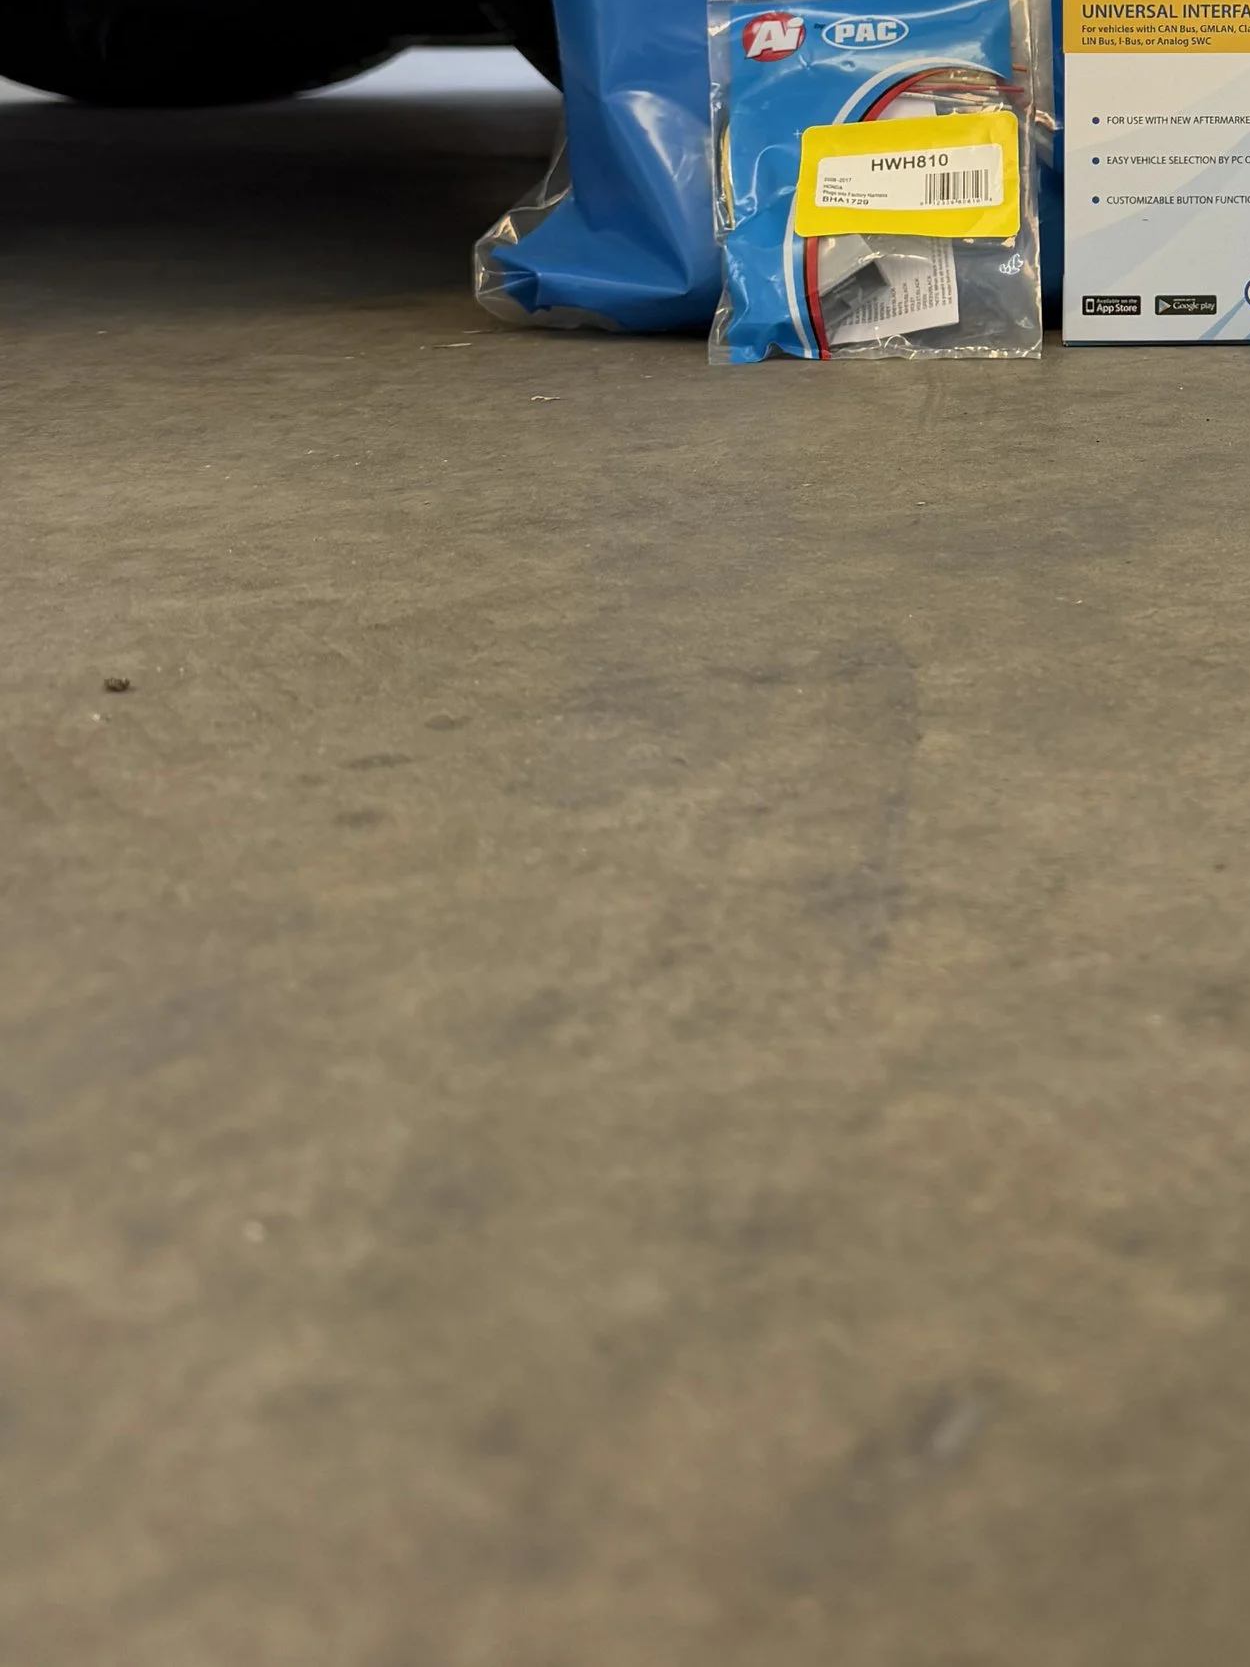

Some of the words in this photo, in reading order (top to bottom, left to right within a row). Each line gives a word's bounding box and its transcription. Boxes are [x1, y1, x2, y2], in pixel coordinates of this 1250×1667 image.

[1082, 4, 1178, 18] UNIVERSAL
[1082, 25, 1096, 33] For
[1098, 24, 1134, 33] vehicles
[1136, 24, 1156, 33] with
[1158, 25, 1178, 34] CAN
[1180, 25, 1198, 35] Bus,
[1200, 25, 1237, 35] GMLAN,
[747, 17, 804, 58] Ai
[835, 22, 897, 43] PAC
[1082, 37, 1096, 46] LIN
[1099, 37, 1117, 46] Bus,
[1119, 37, 1144, 46] I-Bus,
[1145, 38, 1155, 46] or
[1157, 37, 1189, 47] Analog
[1191, 37, 1212, 46] SWC
[1107, 116, 1125, 124] FOR
[1126, 116, 1144, 124] USE
[1146, 116, 1168, 124] WITH
[1170, 116, 1191, 124] NEW
[871, 153, 949, 172] HWH810
[1107, 156, 1129, 164] EASY
[1131, 156, 1167, 164] VEHICLE
[1168, 156, 1216, 164] SELECTION
[1218, 156, 1230, 164] BY
[1231, 156, 1244, 164] PC
[1107, 196, 1175, 204] CUSTOMIZABLE
[1177, 196, 1213, 204] BUTTON
[1096, 304, 1114, 313] App
[1116, 304, 1137, 312] Store
[1173, 302, 1199, 311] Google
[1201, 302, 1215, 311] play
